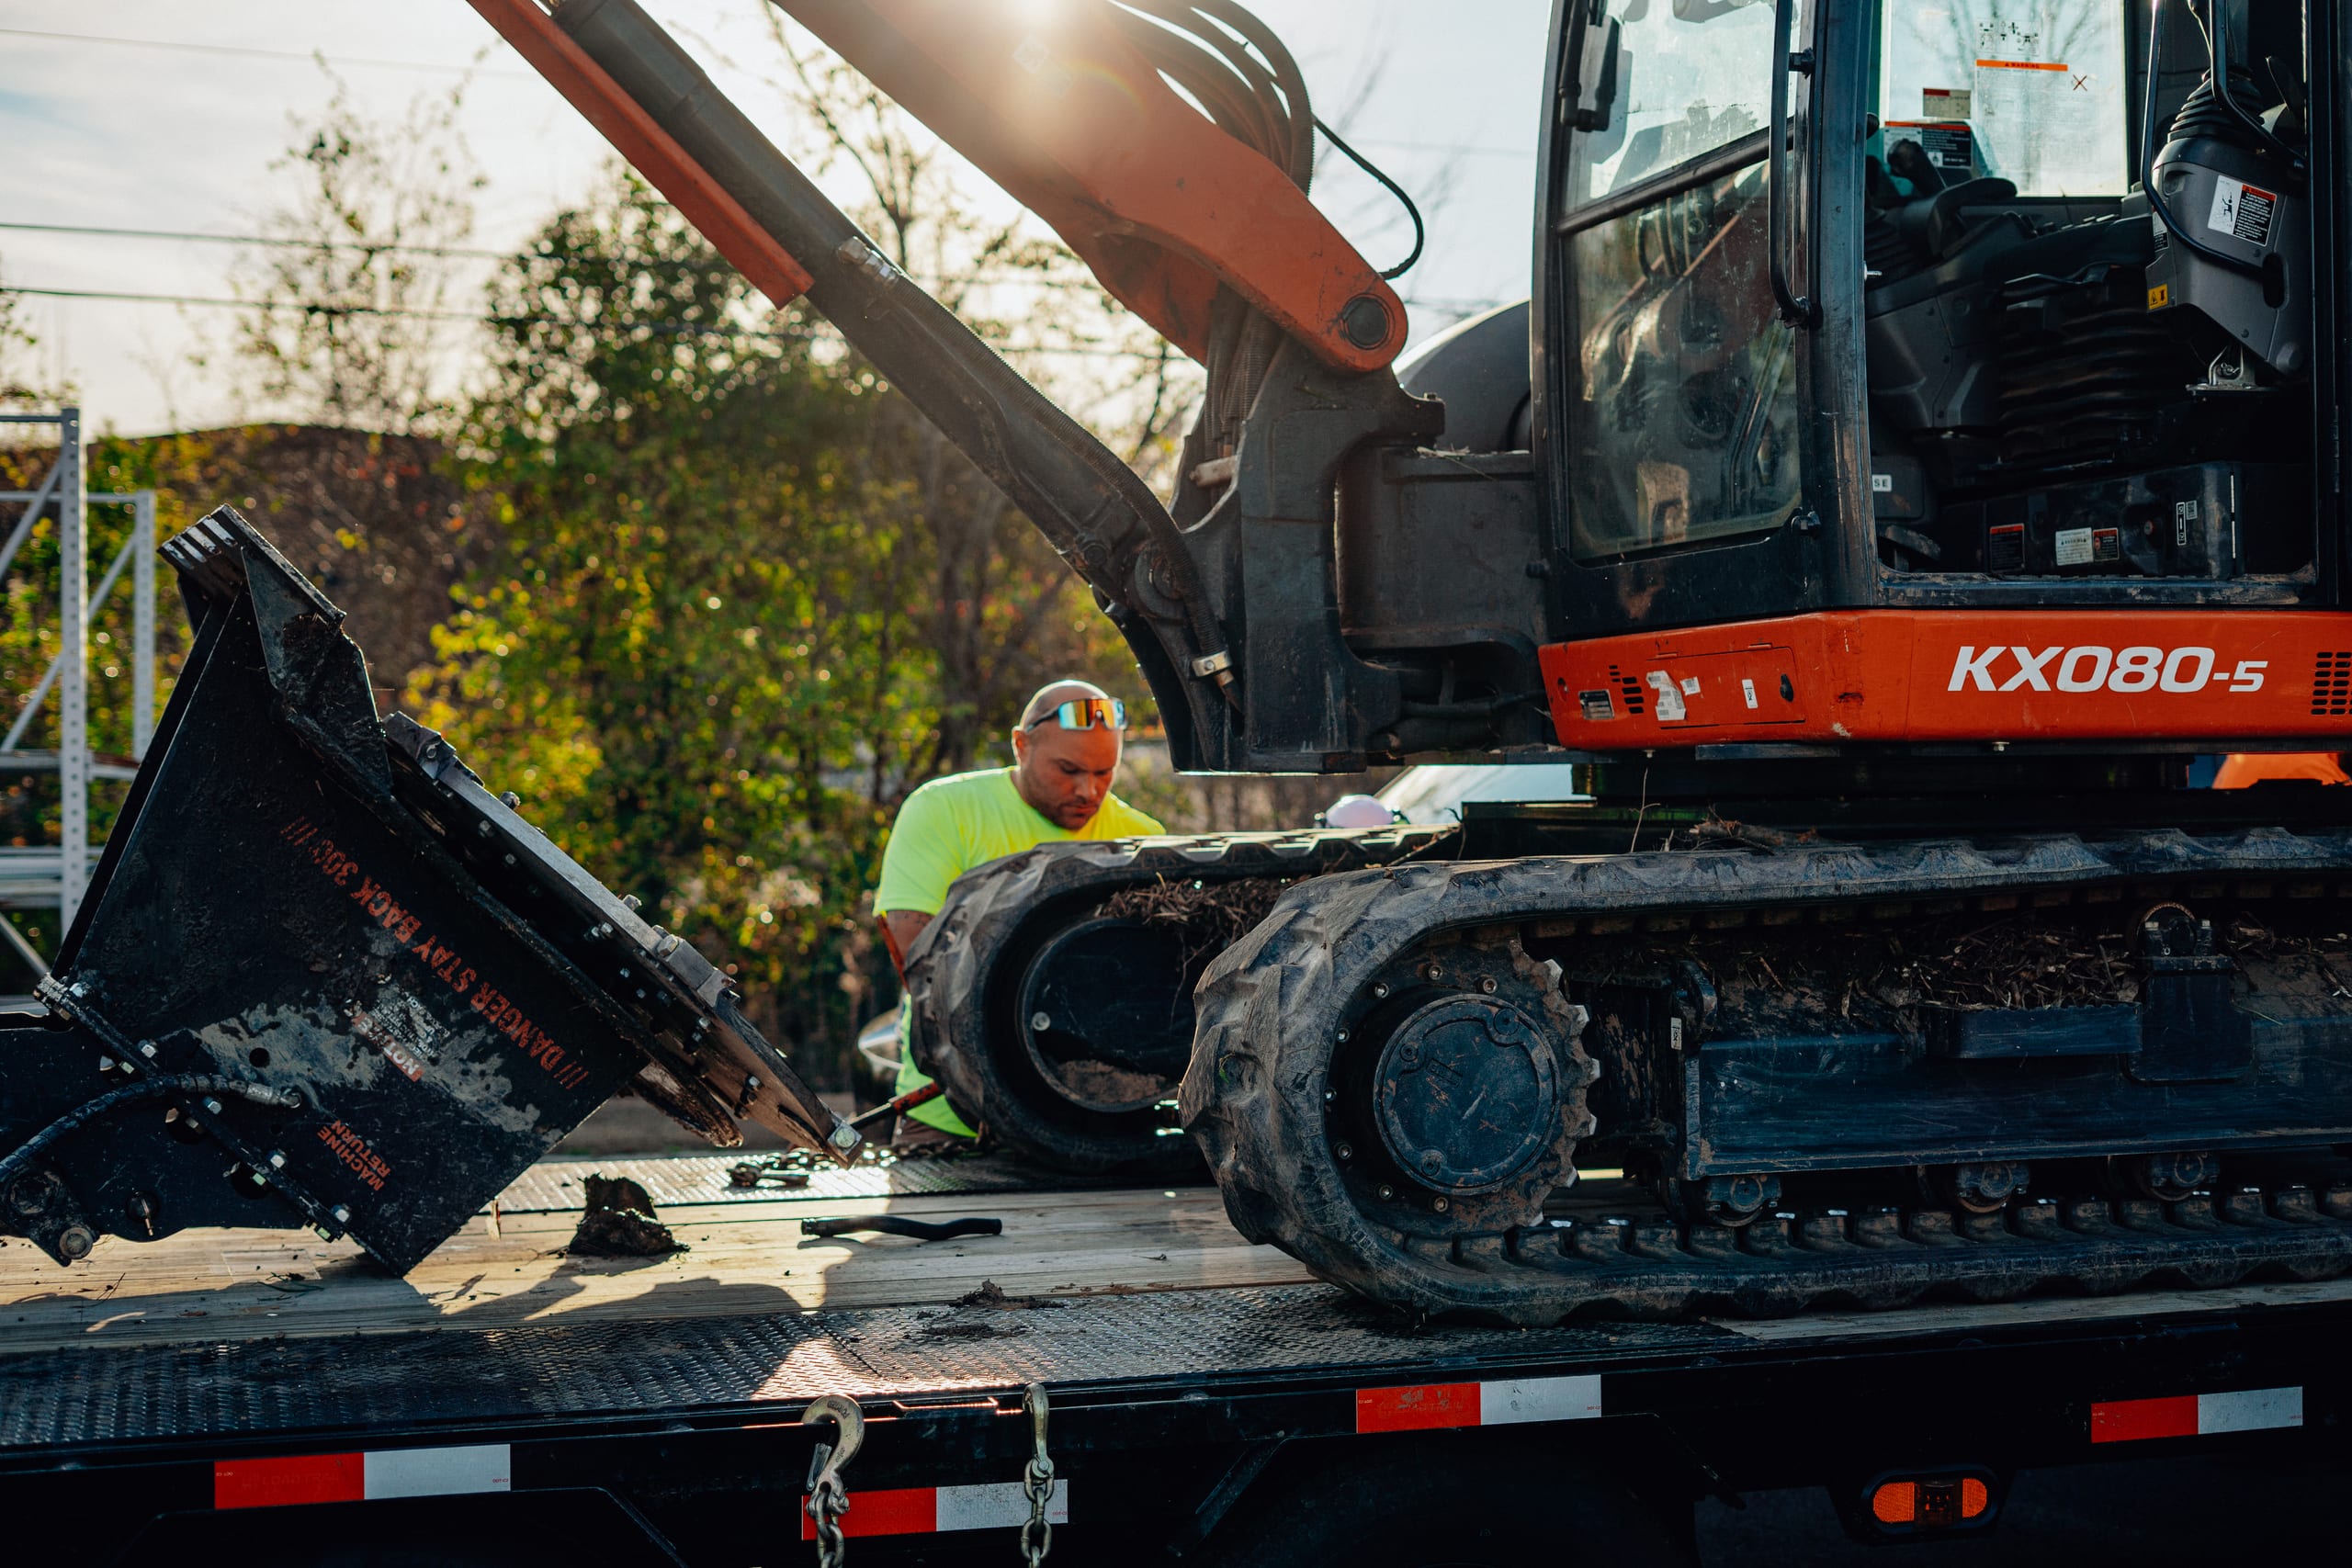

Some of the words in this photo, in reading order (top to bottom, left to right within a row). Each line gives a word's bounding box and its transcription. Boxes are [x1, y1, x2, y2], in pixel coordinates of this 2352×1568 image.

[1947, 646, 2268, 693] KX080-5
[350, 874, 423, 944] BACK
[412, 934, 477, 993] STAY
[470, 982, 566, 1072] DANGER
[316, 1125, 385, 1191] MACHINE
[331, 1119, 391, 1179] RETURN
